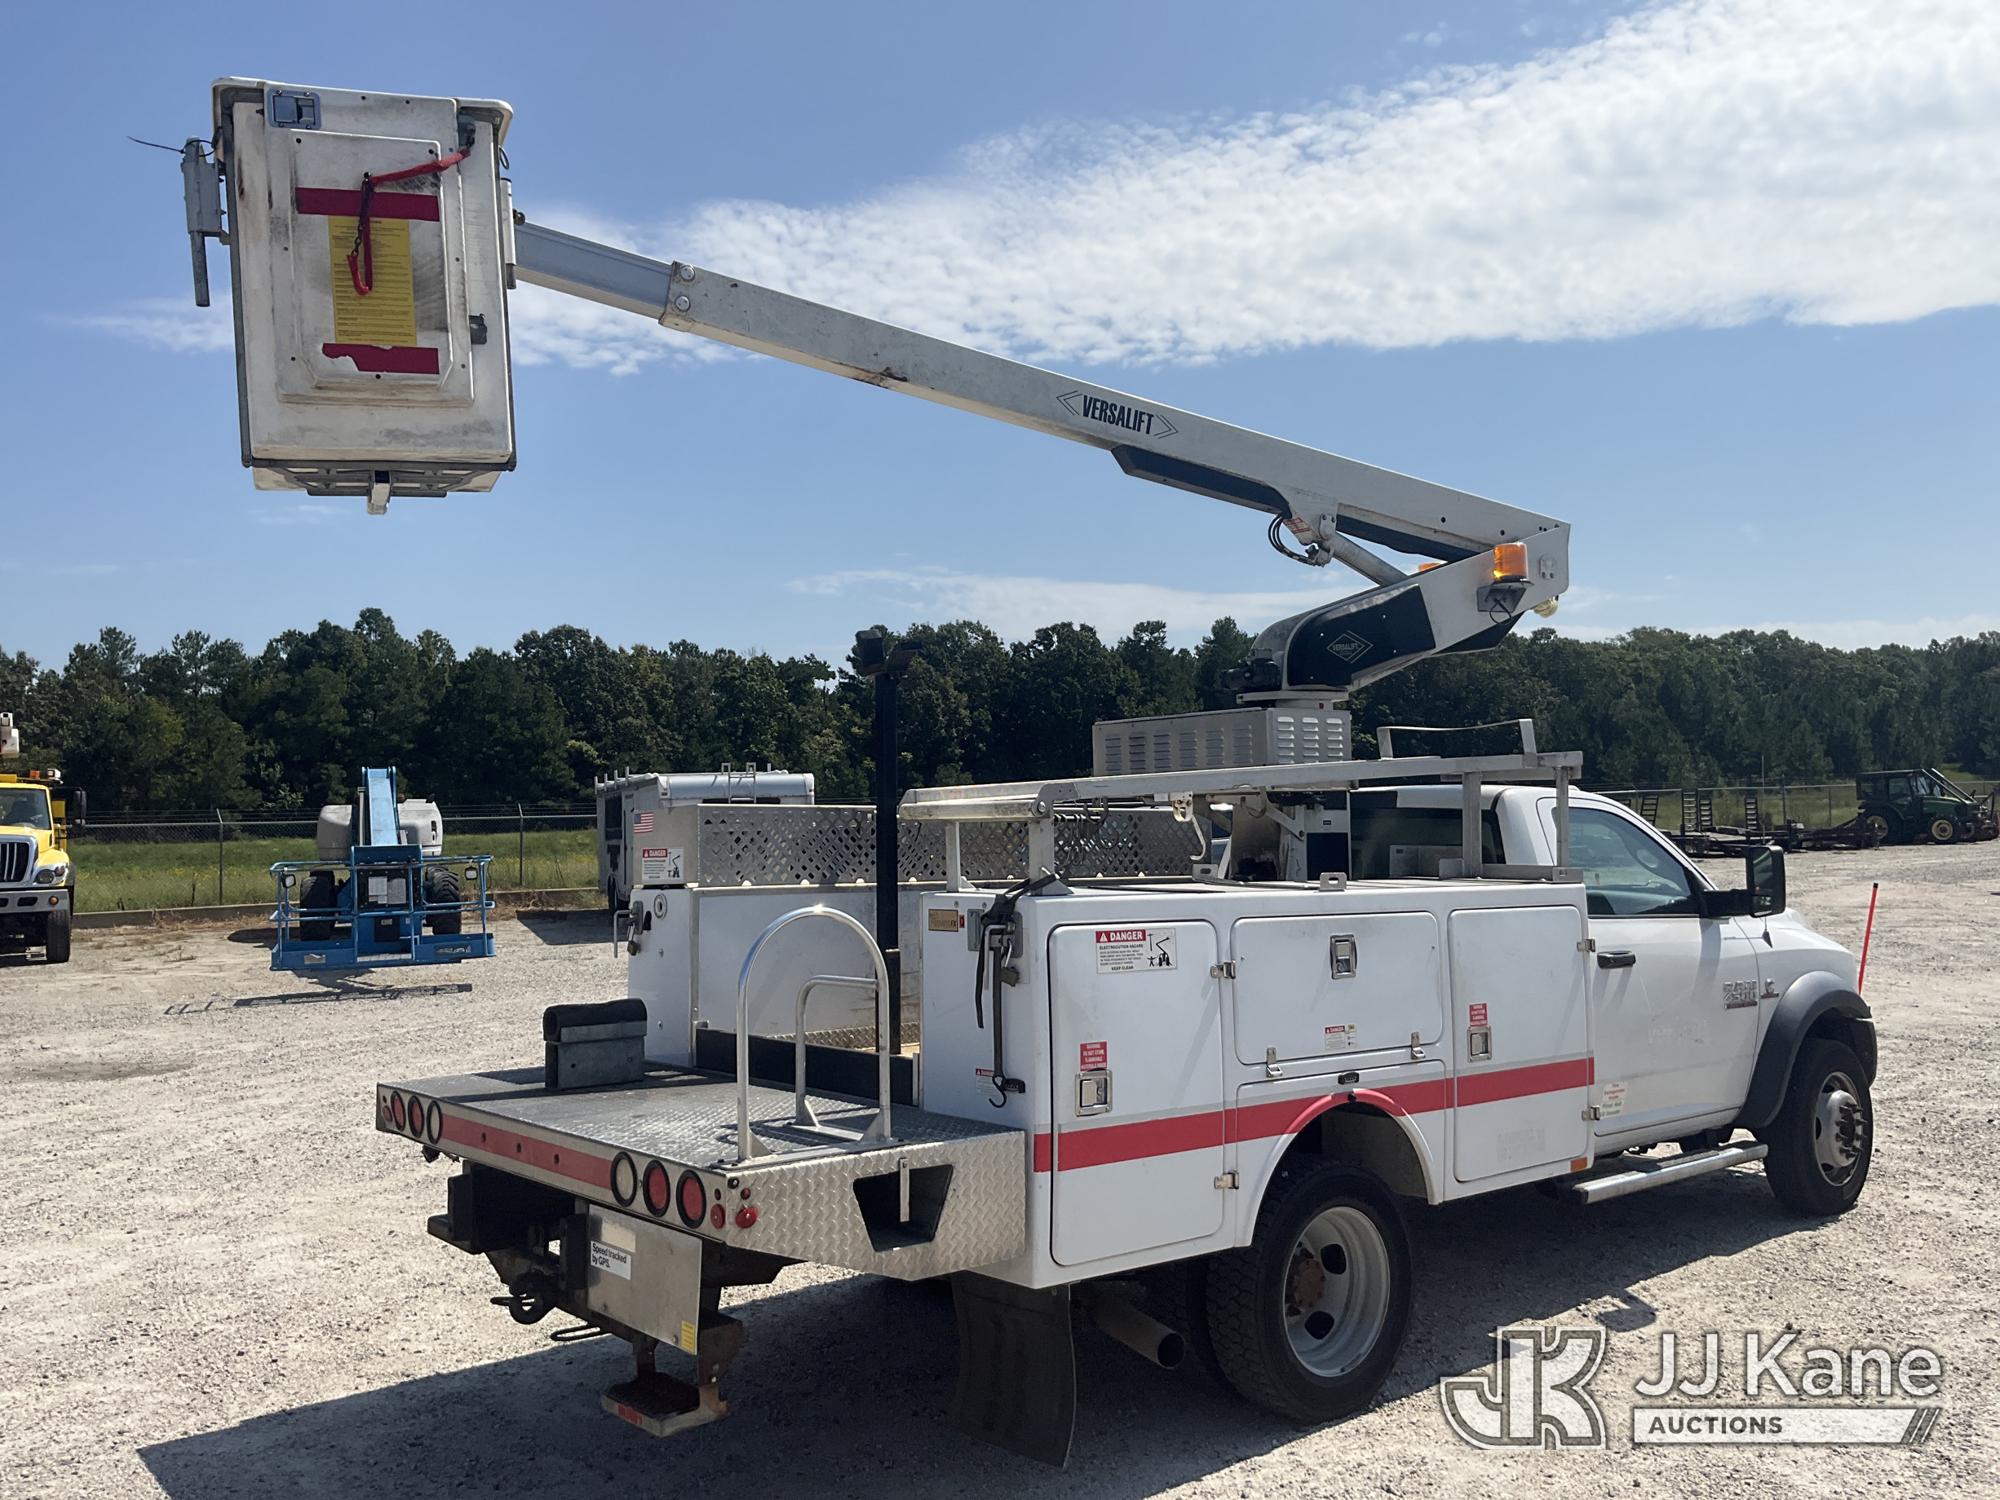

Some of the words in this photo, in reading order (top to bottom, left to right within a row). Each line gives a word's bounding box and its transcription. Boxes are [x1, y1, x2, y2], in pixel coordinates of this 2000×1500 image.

[1082, 395, 1154, 435] VERSALIFT
[1110, 931, 1143, 941] DANGER
[592, 1243, 608, 1256] Speed
[608, 1249, 627, 1264] tracked
[592, 1253, 598, 1265] by
